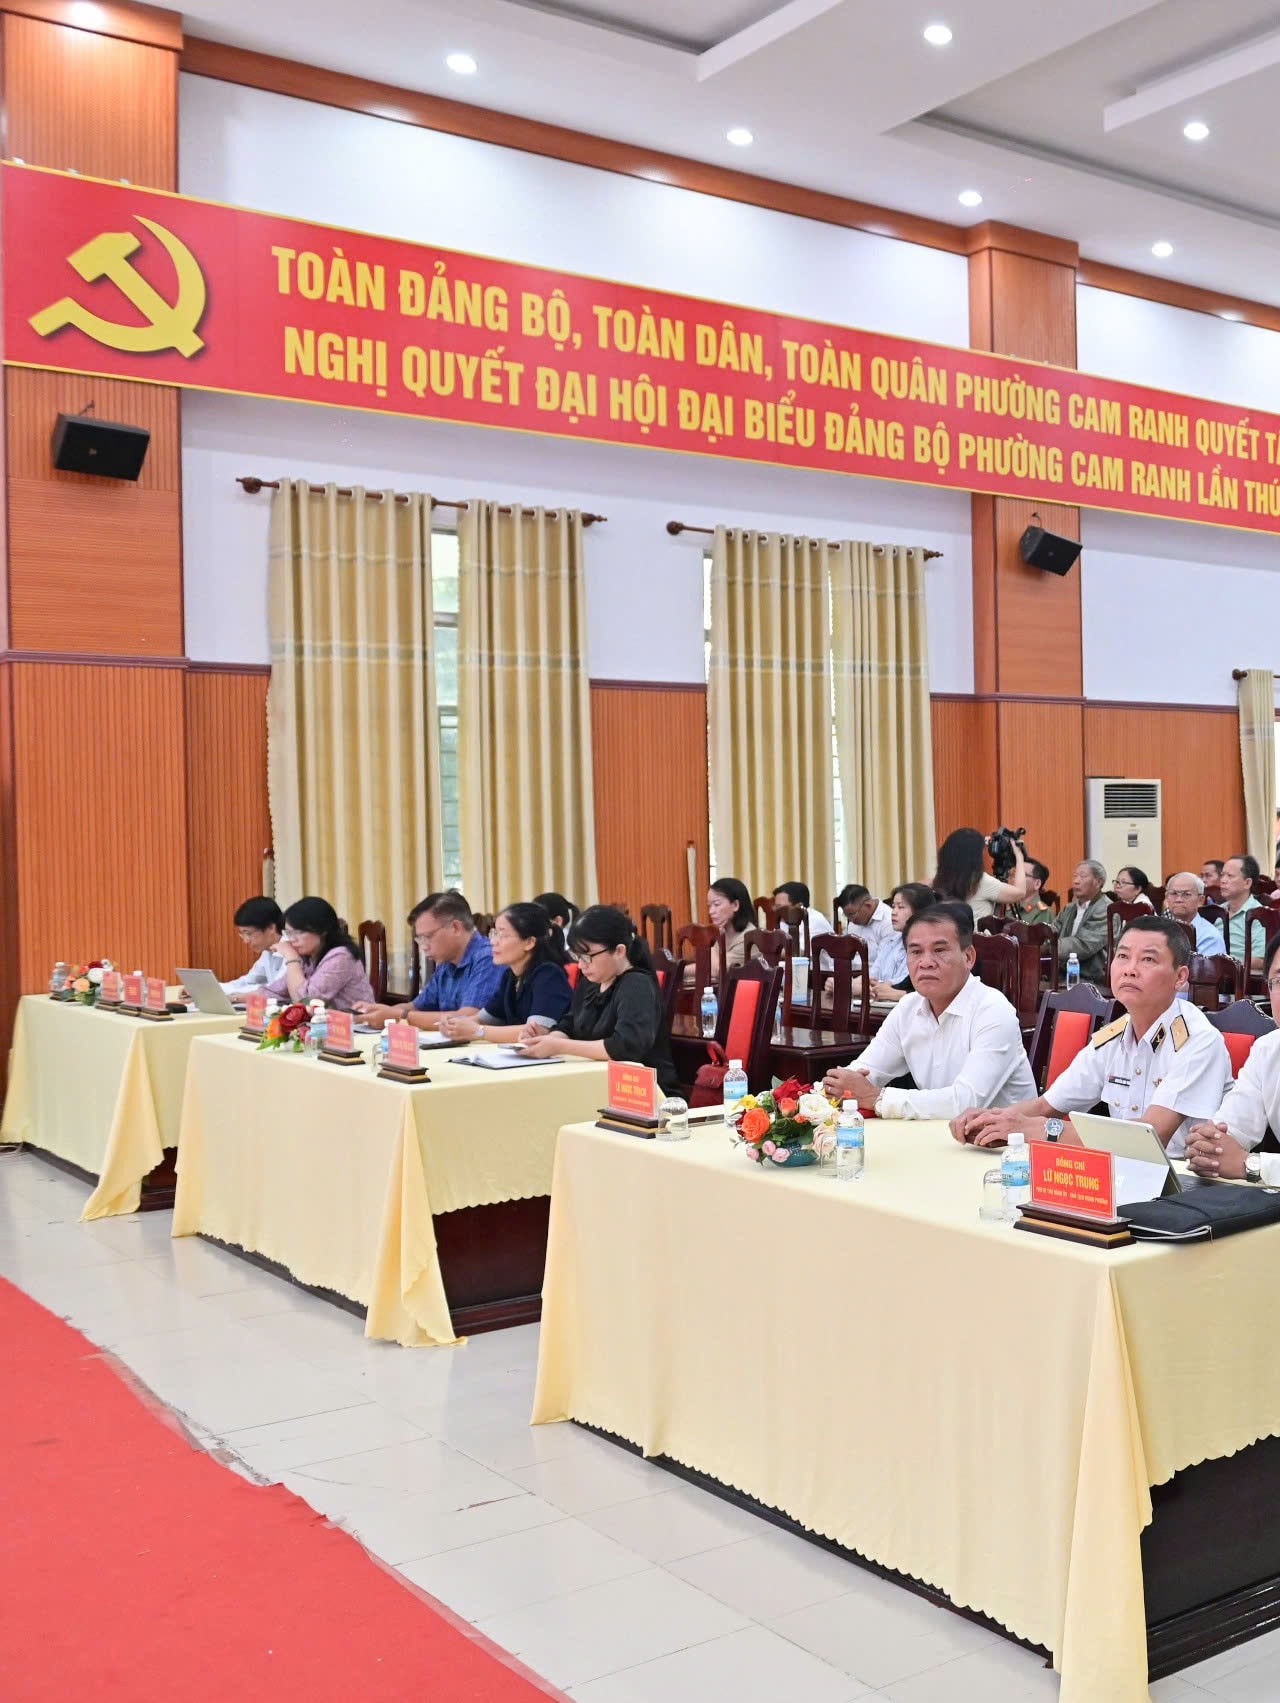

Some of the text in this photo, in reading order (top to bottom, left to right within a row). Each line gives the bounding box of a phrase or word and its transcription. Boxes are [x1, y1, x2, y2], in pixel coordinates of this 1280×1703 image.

[271, 245, 385, 311] TOÀN
[398, 261, 509, 333] ĐẢNG
[521, 288, 582, 349] BỘ,
[592, 305, 685, 362] TOÀN
[695, 320, 773, 380] DÂN,
[783, 339, 862, 392] TOÀN
[870, 356, 948, 406] QUÂN
[955, 371, 1061, 425] PHƯỜNG
[1068, 393, 1122, 436] CAM
[1128, 404, 1189, 449] RANH
[1195, 417, 1261, 461] QUYẾT
[284, 326, 388, 398] NGHỊ
[402, 345, 525, 406] QUYẾT
[535, 366, 598, 424] ĐẠI
[609, 373, 667, 434] HỘI
[677, 388, 734, 443] ĐẠI
[744, 390, 816, 448] BIỂU
[824, 403, 905, 461] ĐẢNG
[913, 421, 951, 475] BỘ
[959, 432, 1064, 483] PHƯỜNG
[1071, 450, 1124, 492] CAM
[1131, 460, 1192, 502] RANH
[1197, 466, 1239, 510] LẦN
[1054, 1171, 1073, 1187] NGỌC
[1075, 1174, 1100, 1191] TRUNG
